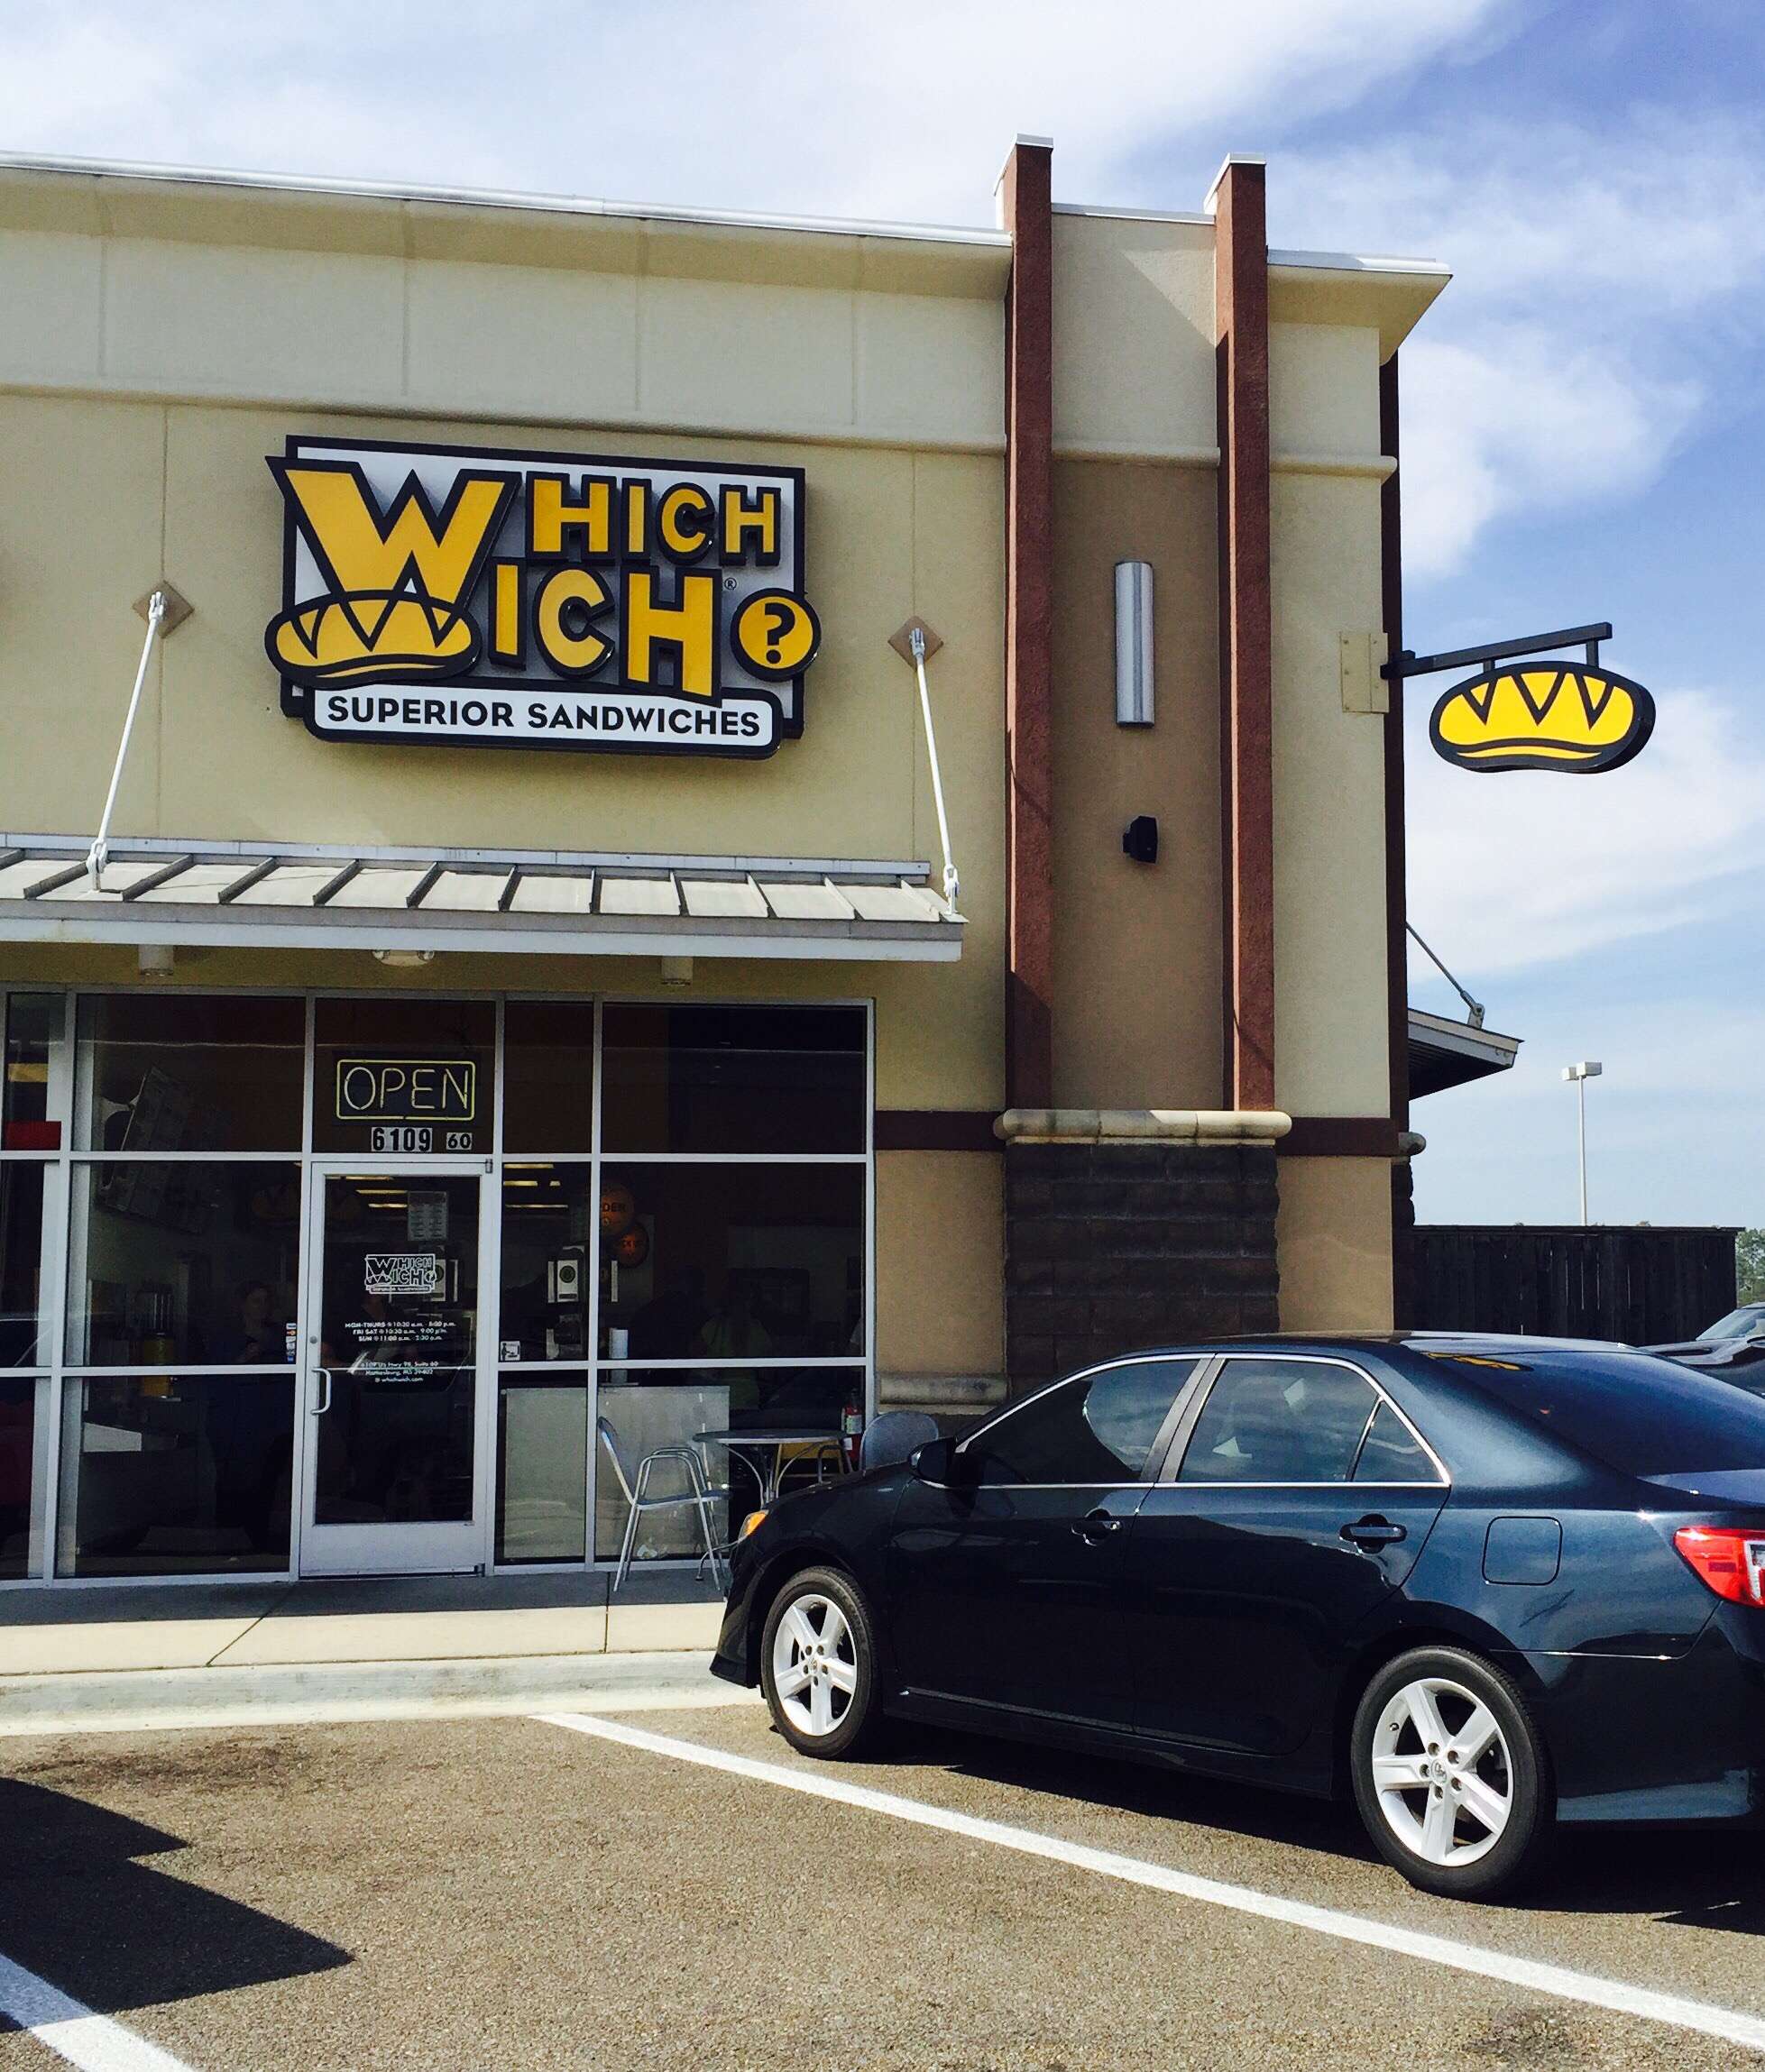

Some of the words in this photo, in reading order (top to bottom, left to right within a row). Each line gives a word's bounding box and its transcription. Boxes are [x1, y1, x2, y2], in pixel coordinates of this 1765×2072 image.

[281, 466, 777, 604] WHICH
[326, 695, 515, 729] SUPERIOR
[528, 703, 761, 738] SANDWICHES
[344, 1066, 469, 1111] OPEN
[372, 1127, 431, 1151] 6109
[447, 1133, 471, 1149] 60
